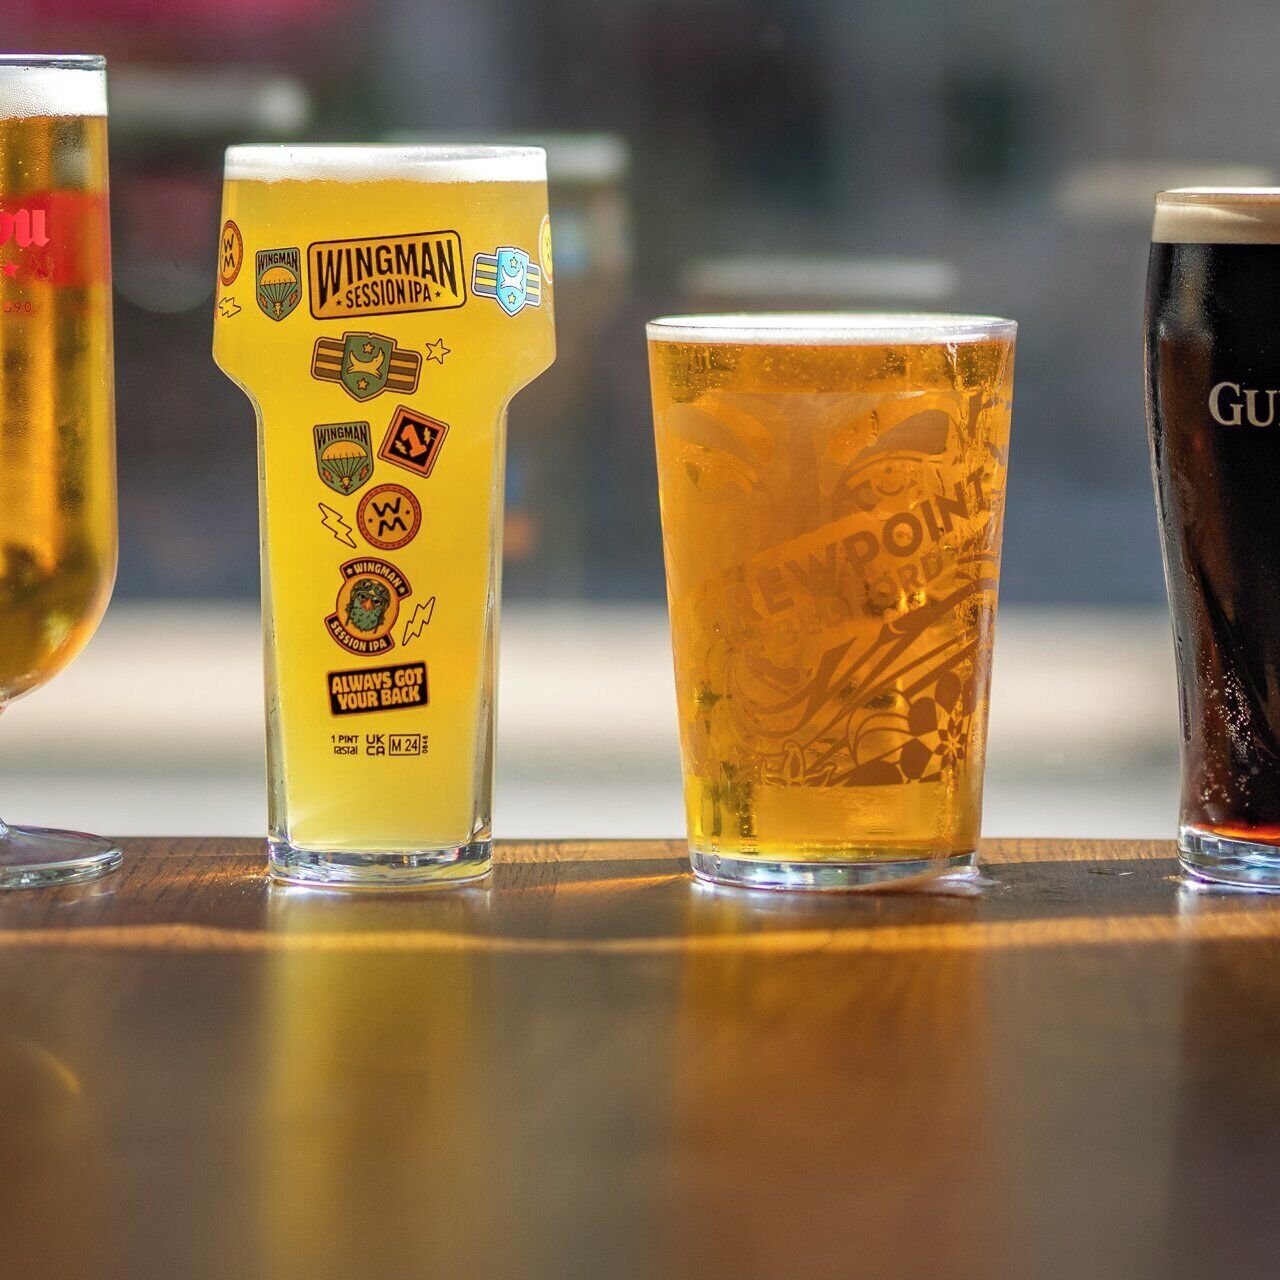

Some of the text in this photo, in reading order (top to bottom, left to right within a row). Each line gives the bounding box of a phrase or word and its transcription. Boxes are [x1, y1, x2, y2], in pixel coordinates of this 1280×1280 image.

[257, 250, 298, 275] WINGMAN
[316, 239, 459, 310] WINGMAN
[345, 278, 432, 309] SESSION IPA
[316, 425, 368, 450] WINGMAN
[400, 424, 427, 458] 1
[353, 562, 402, 587] WINGMAN
[330, 621, 387, 651] SESSION IPA
[332, 668, 423, 694] ALWAYS GOT
[337, 685, 421, 710] YOUR BACK
[331, 735, 359, 744] 1 PINT
[366, 734, 385, 745] UK
[366, 746, 386, 756] CA
[391, 738, 418, 752] M 24
